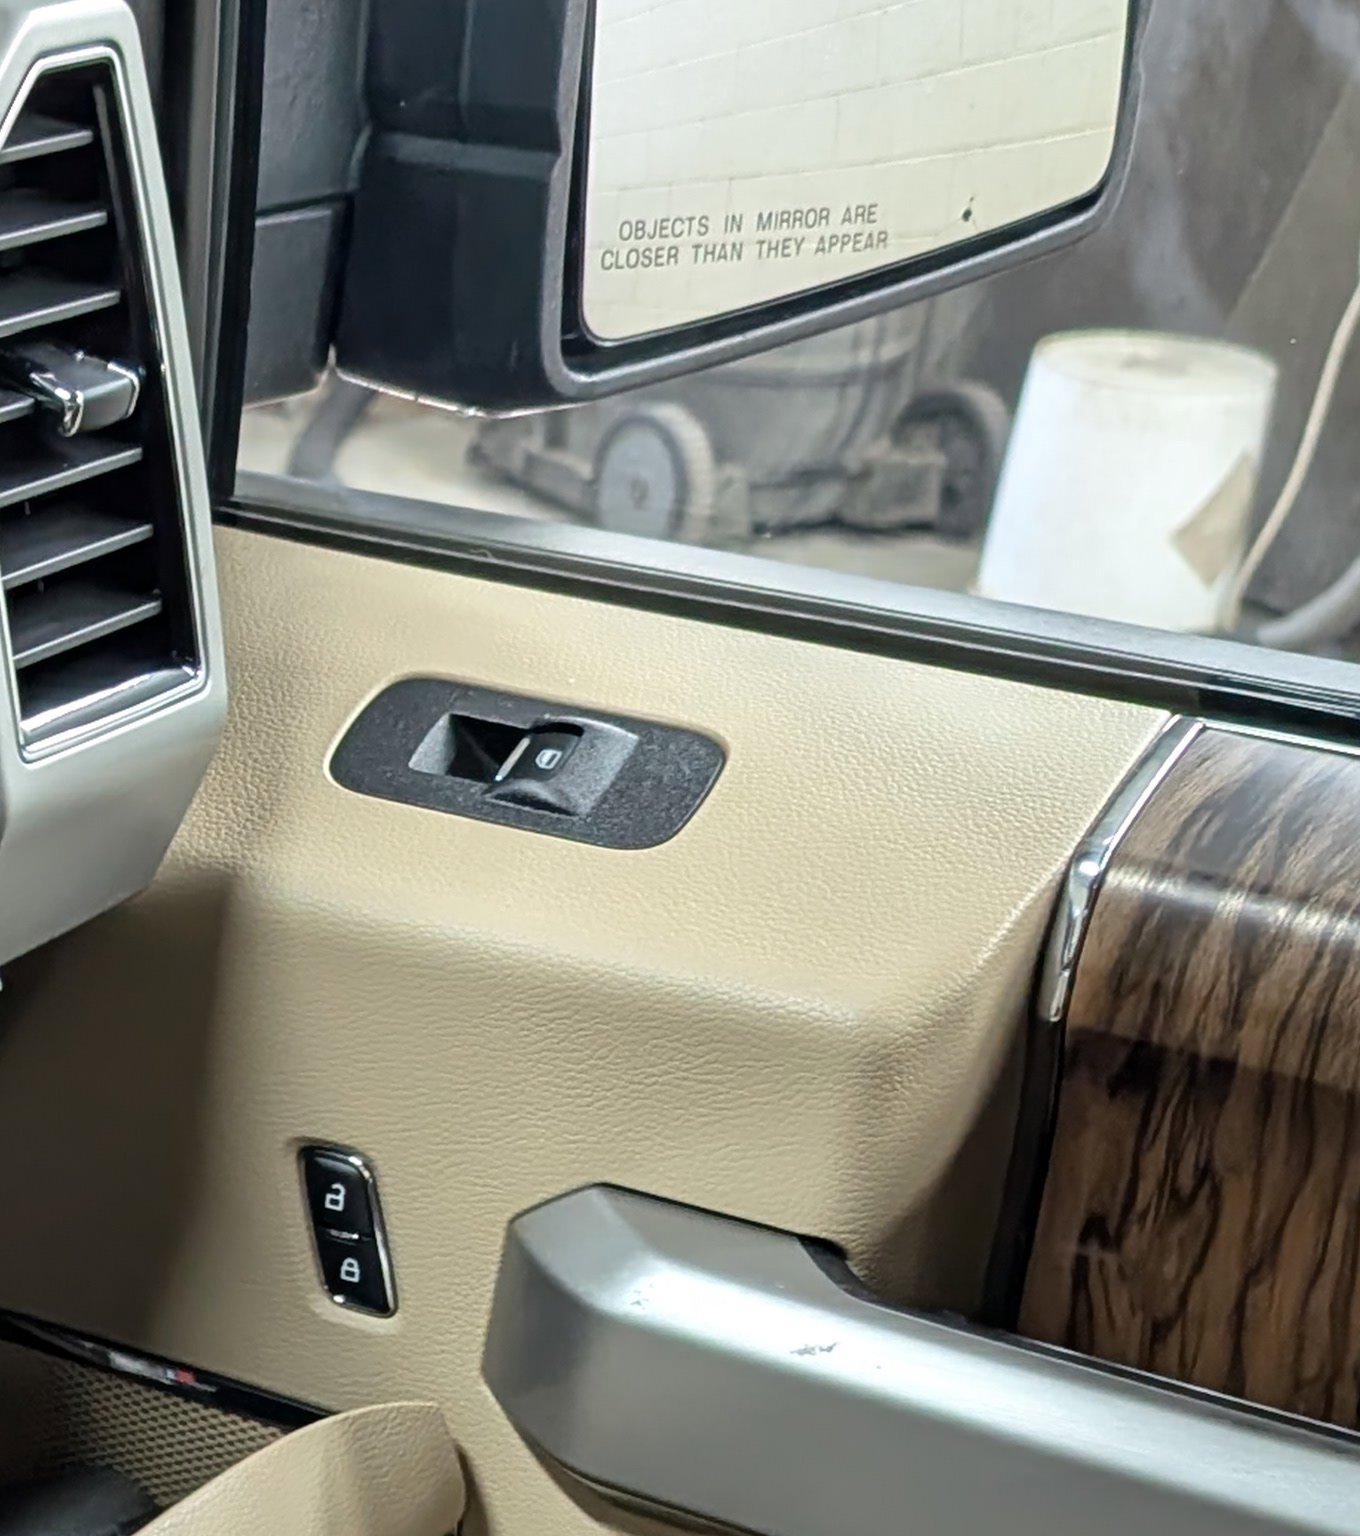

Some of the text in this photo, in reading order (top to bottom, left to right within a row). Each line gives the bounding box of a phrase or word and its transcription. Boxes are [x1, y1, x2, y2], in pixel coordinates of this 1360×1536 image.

[618, 203, 879, 242] OBJECTS IN MIRROR ARE
[600, 230, 889, 271] CLOSER THAN THEY APPEAR
